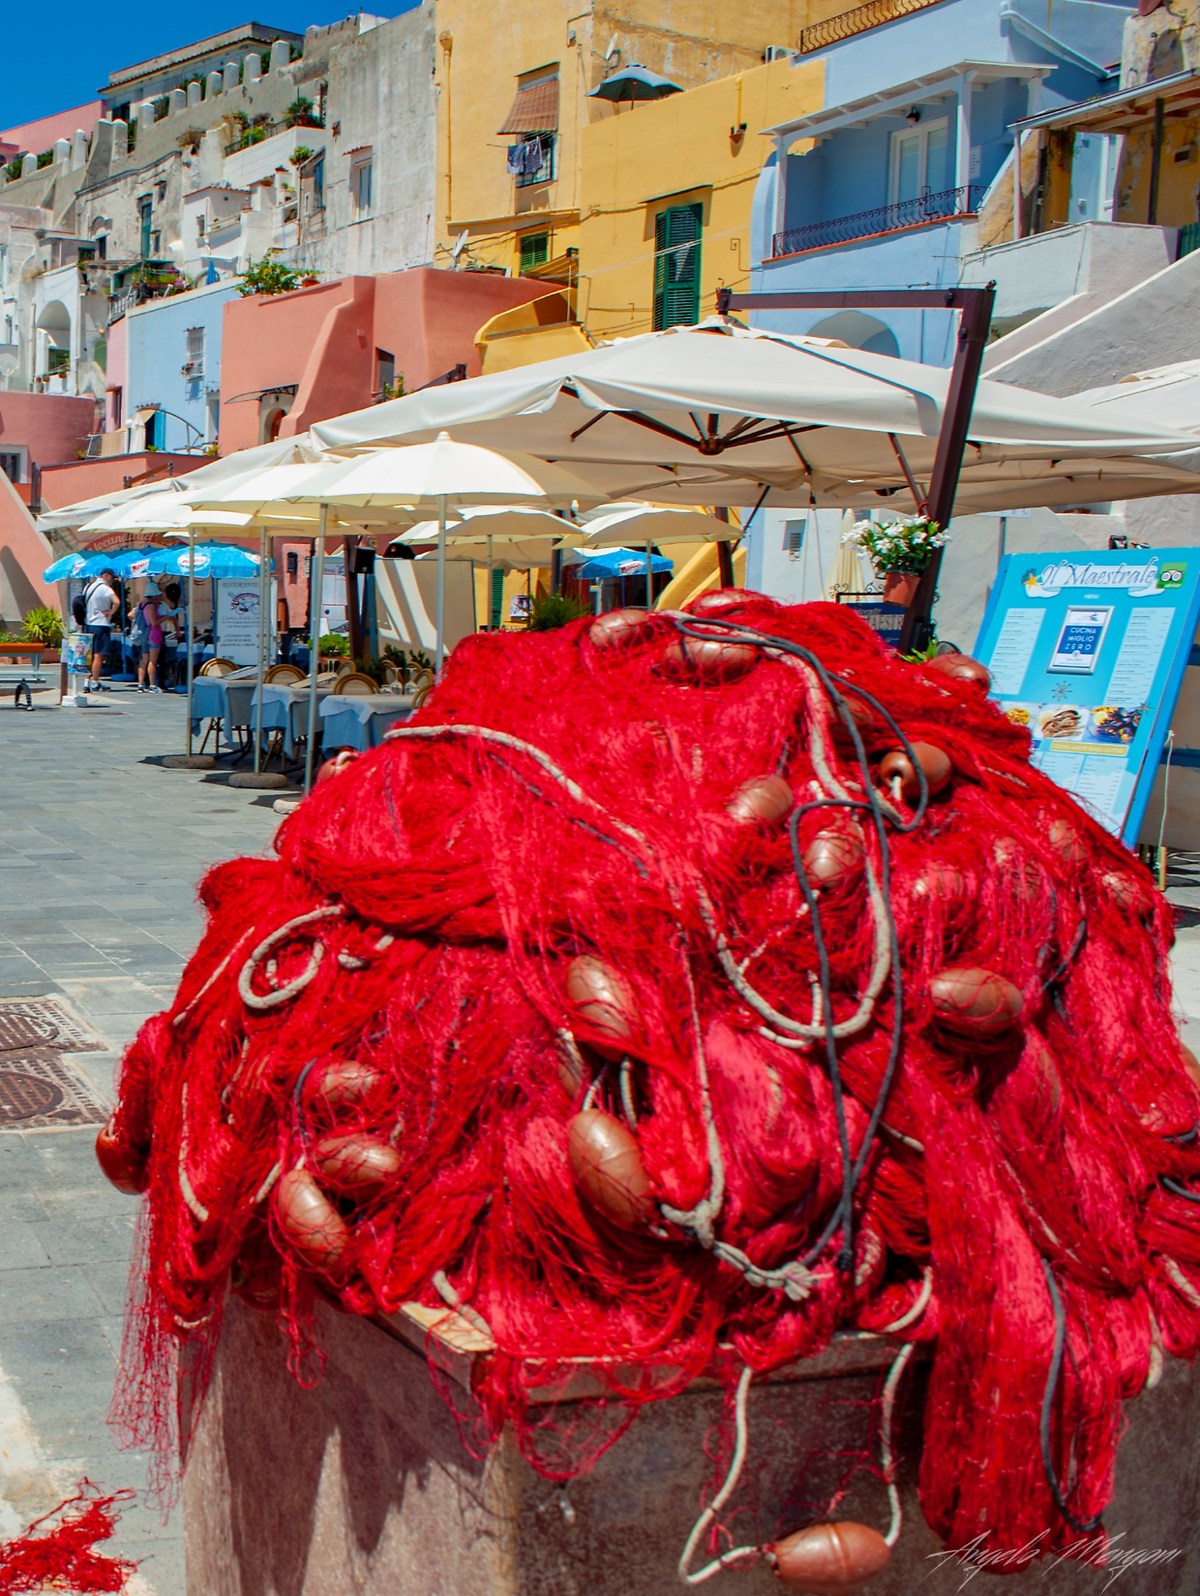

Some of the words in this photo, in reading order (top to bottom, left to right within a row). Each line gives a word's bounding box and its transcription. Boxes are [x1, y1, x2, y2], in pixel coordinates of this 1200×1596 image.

[1040, 559, 1068, 586] Il
[1063, 556, 1159, 586] Maestrale
[1065, 643, 1092, 651] ZERO
